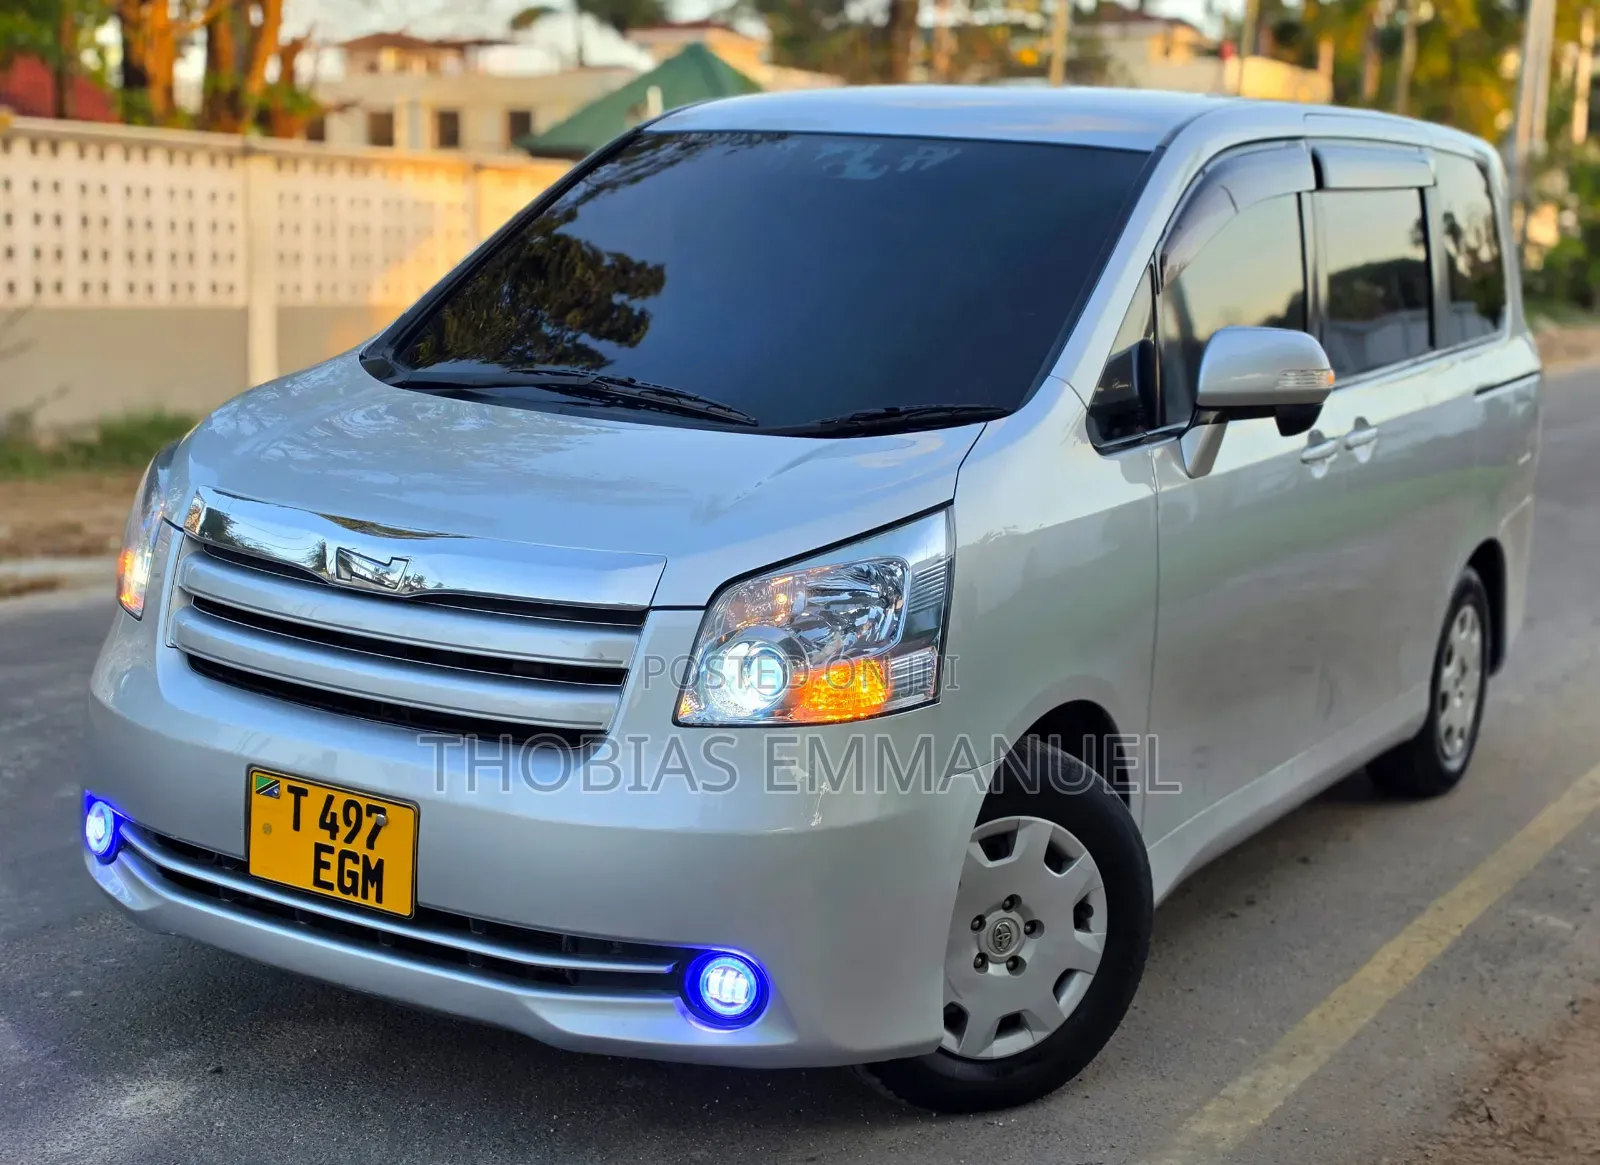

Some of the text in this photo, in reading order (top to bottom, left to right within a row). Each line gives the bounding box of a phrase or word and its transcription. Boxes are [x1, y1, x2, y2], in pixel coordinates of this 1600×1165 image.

[287, 784, 387, 850] T 497
[313, 842, 384, 904] EGM
